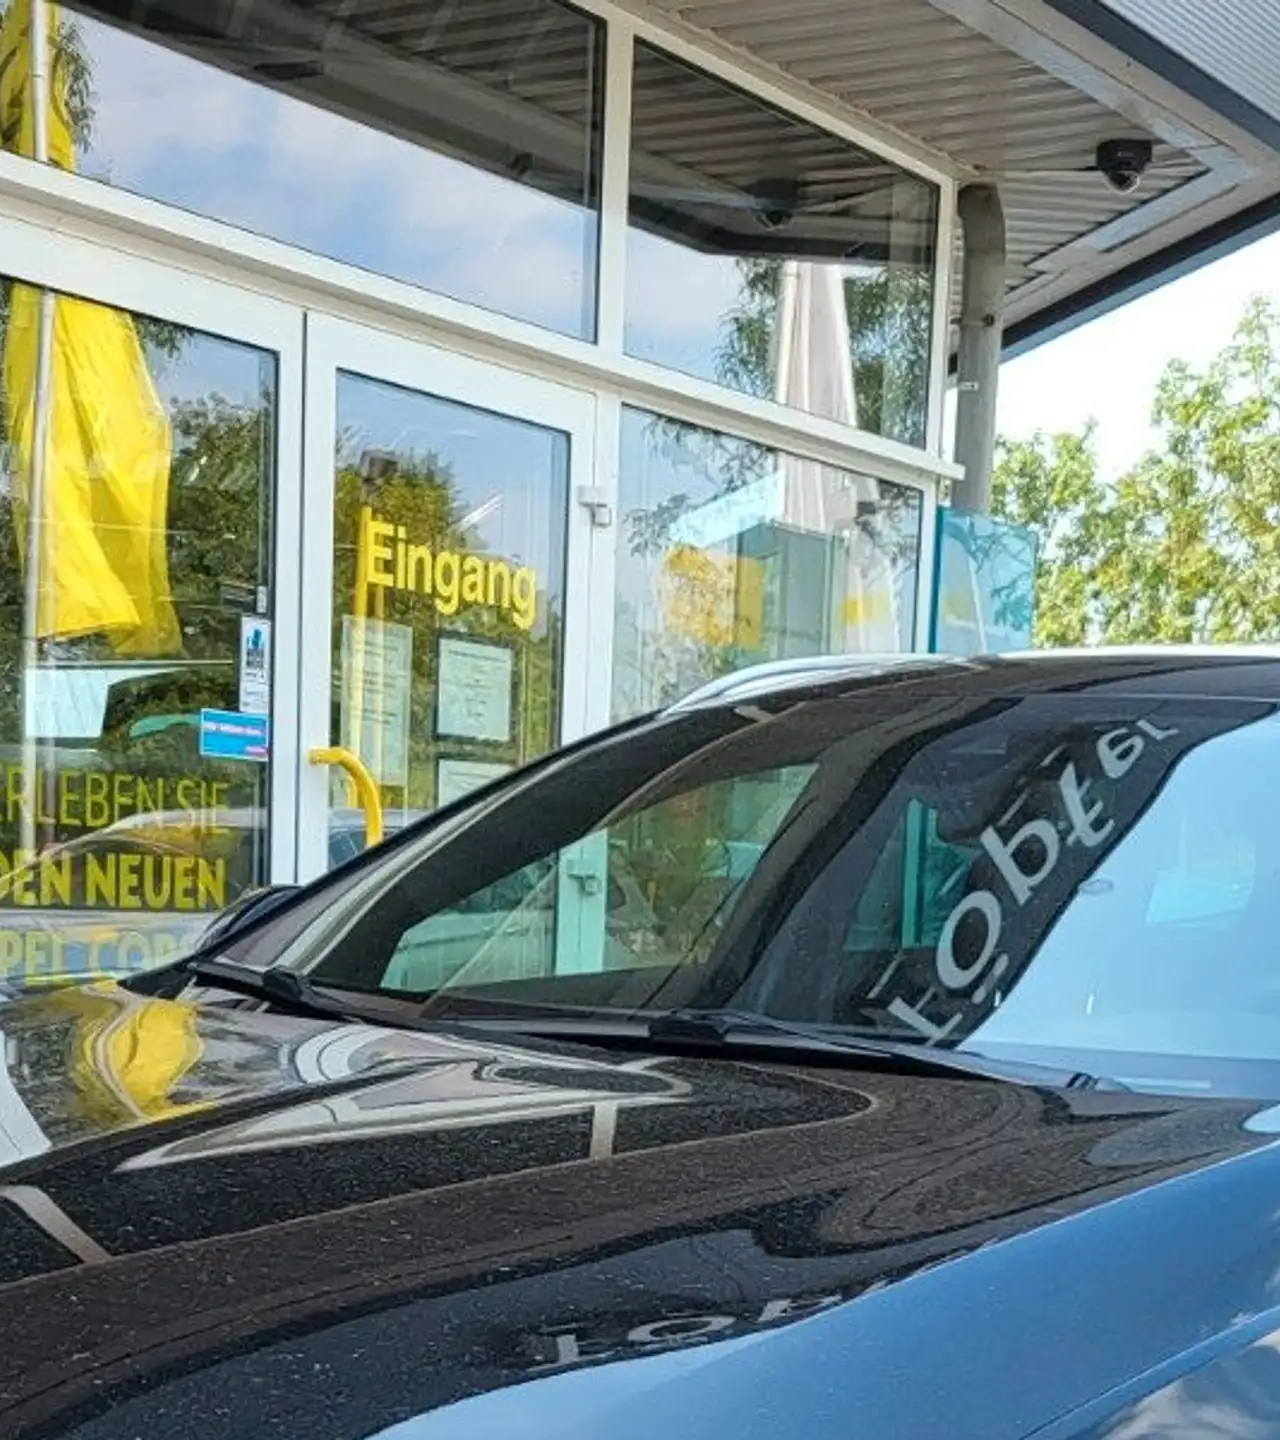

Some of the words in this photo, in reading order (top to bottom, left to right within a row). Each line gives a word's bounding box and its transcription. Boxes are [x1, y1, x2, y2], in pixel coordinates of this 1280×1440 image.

[366, 520, 537, 630] Eingang
[175, 776, 232, 834] SIE
[84, 852, 227, 909] NEUEN
